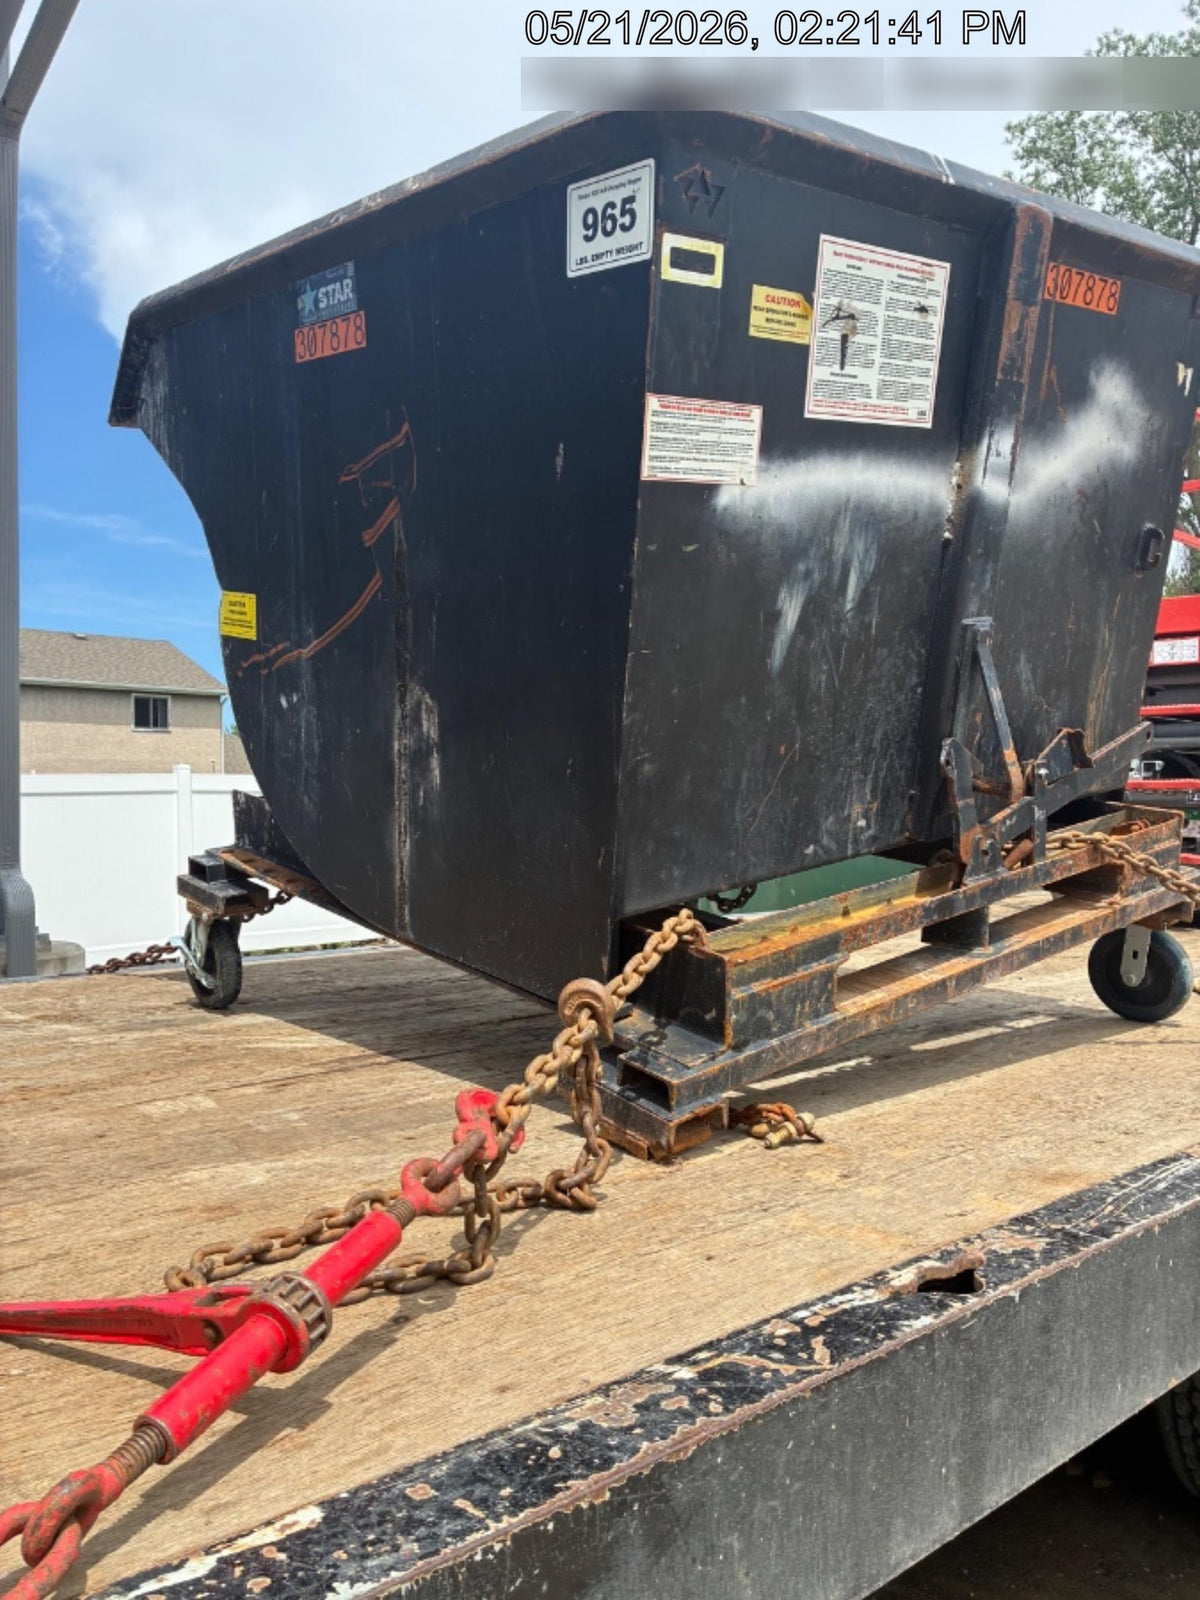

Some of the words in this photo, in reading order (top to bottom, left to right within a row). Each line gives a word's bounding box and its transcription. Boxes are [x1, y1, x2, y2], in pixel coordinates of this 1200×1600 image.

[582, 194, 637, 243] 965
[317, 278, 354, 309] STAR
[765, 294, 801, 308] CAUTION
[1046, 264, 1119, 312] 307878
[296, 313, 365, 360] 307878
